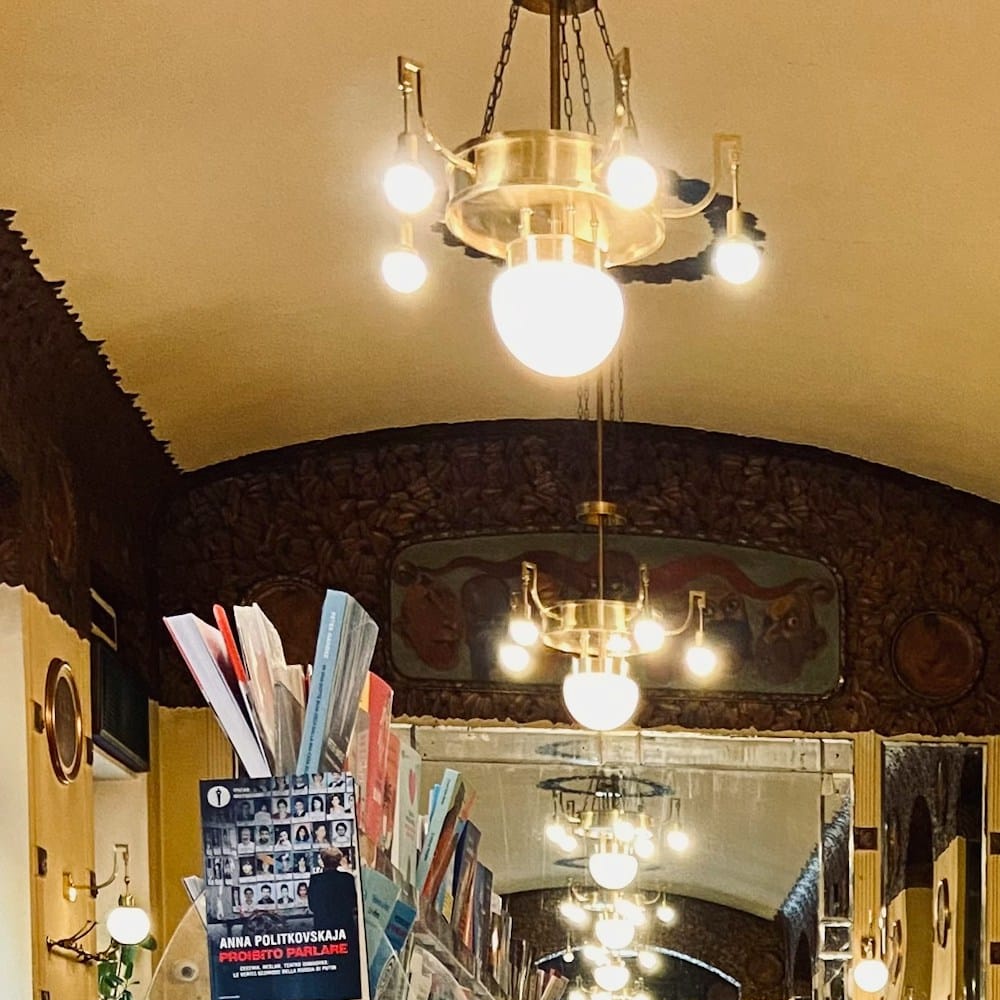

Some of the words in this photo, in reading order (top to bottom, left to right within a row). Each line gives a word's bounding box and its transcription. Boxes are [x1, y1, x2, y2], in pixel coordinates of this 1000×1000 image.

[219, 935, 252, 949] ANNA
[254, 929, 347, 947] POLITKOVSKAJA
[219, 950, 284, 962] PROIBITO
[286, 943, 348, 958] PARLARE
